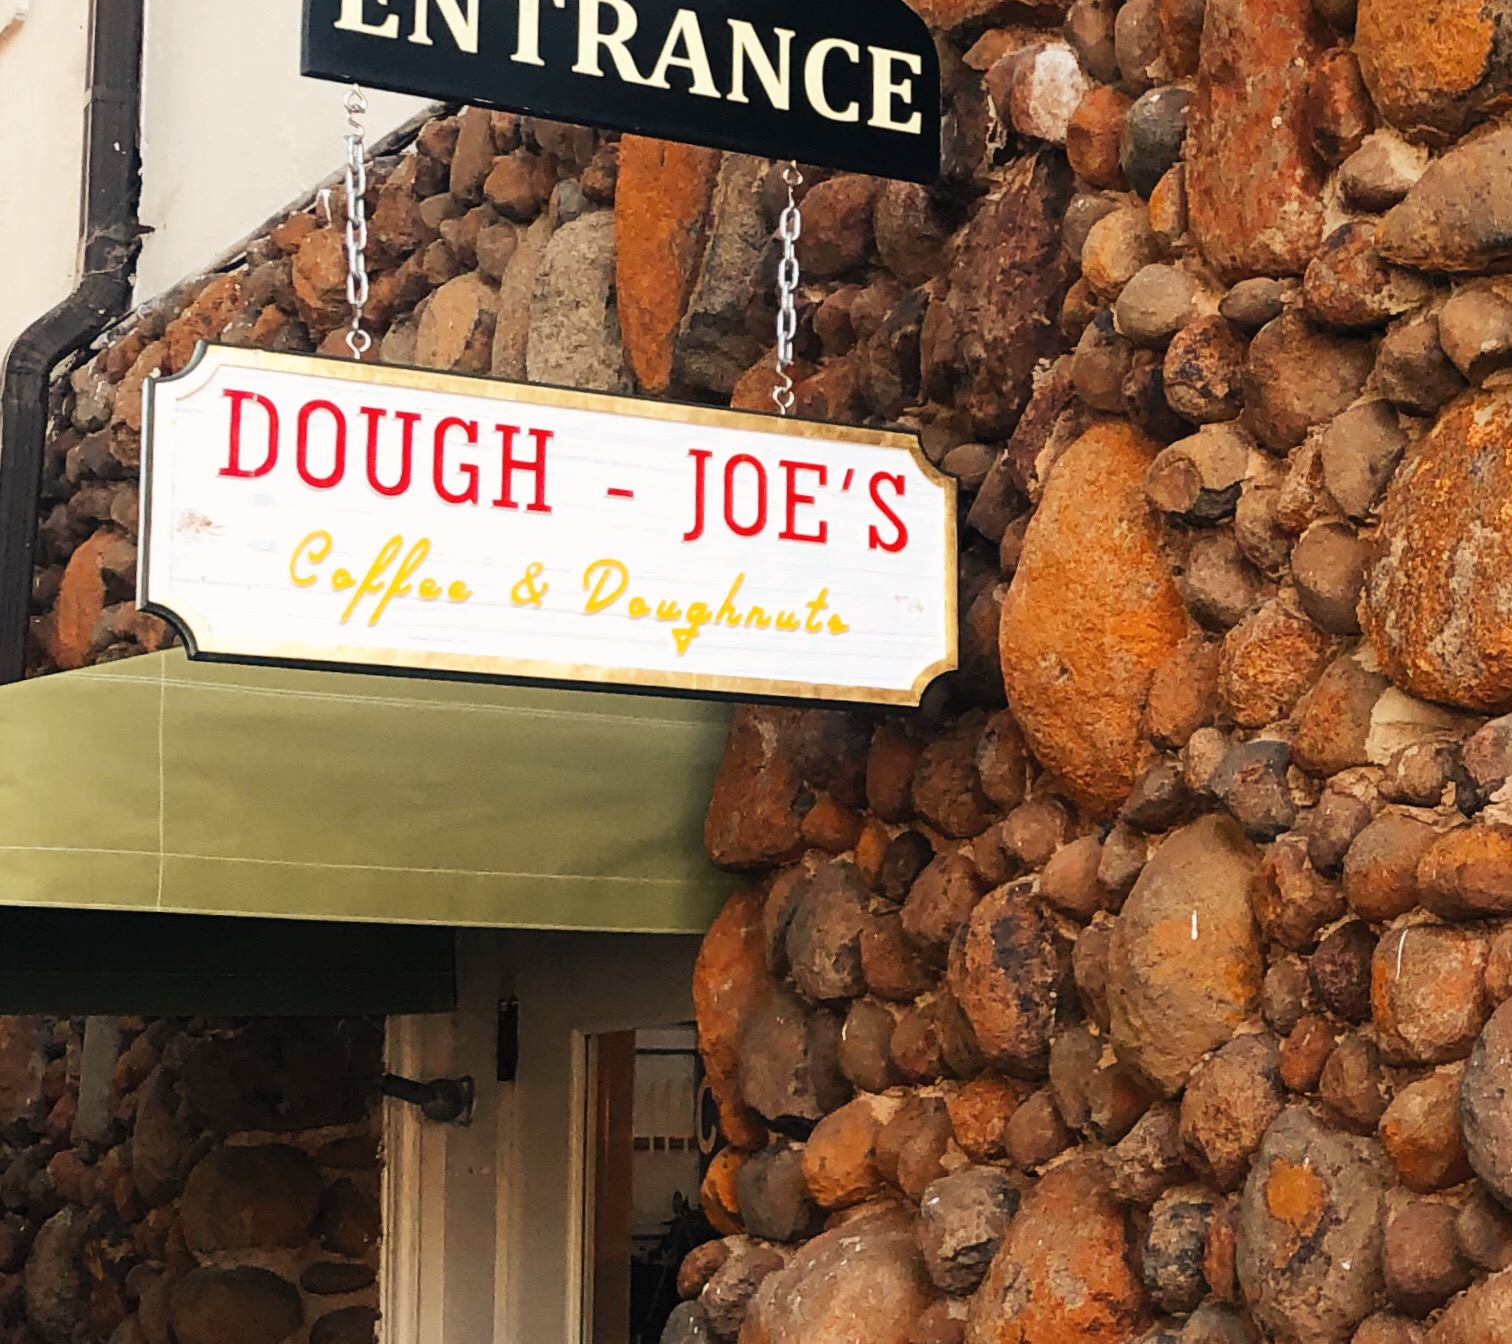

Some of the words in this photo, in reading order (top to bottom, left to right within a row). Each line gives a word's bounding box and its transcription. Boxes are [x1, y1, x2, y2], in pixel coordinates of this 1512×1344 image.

[218, 388, 555, 514] DOUGH
[682, 447, 910, 555] JOE'S
[288, 529, 473, 626] Coffee
[510, 562, 549, 607] &
[582, 558, 850, 654] Doughnuts
